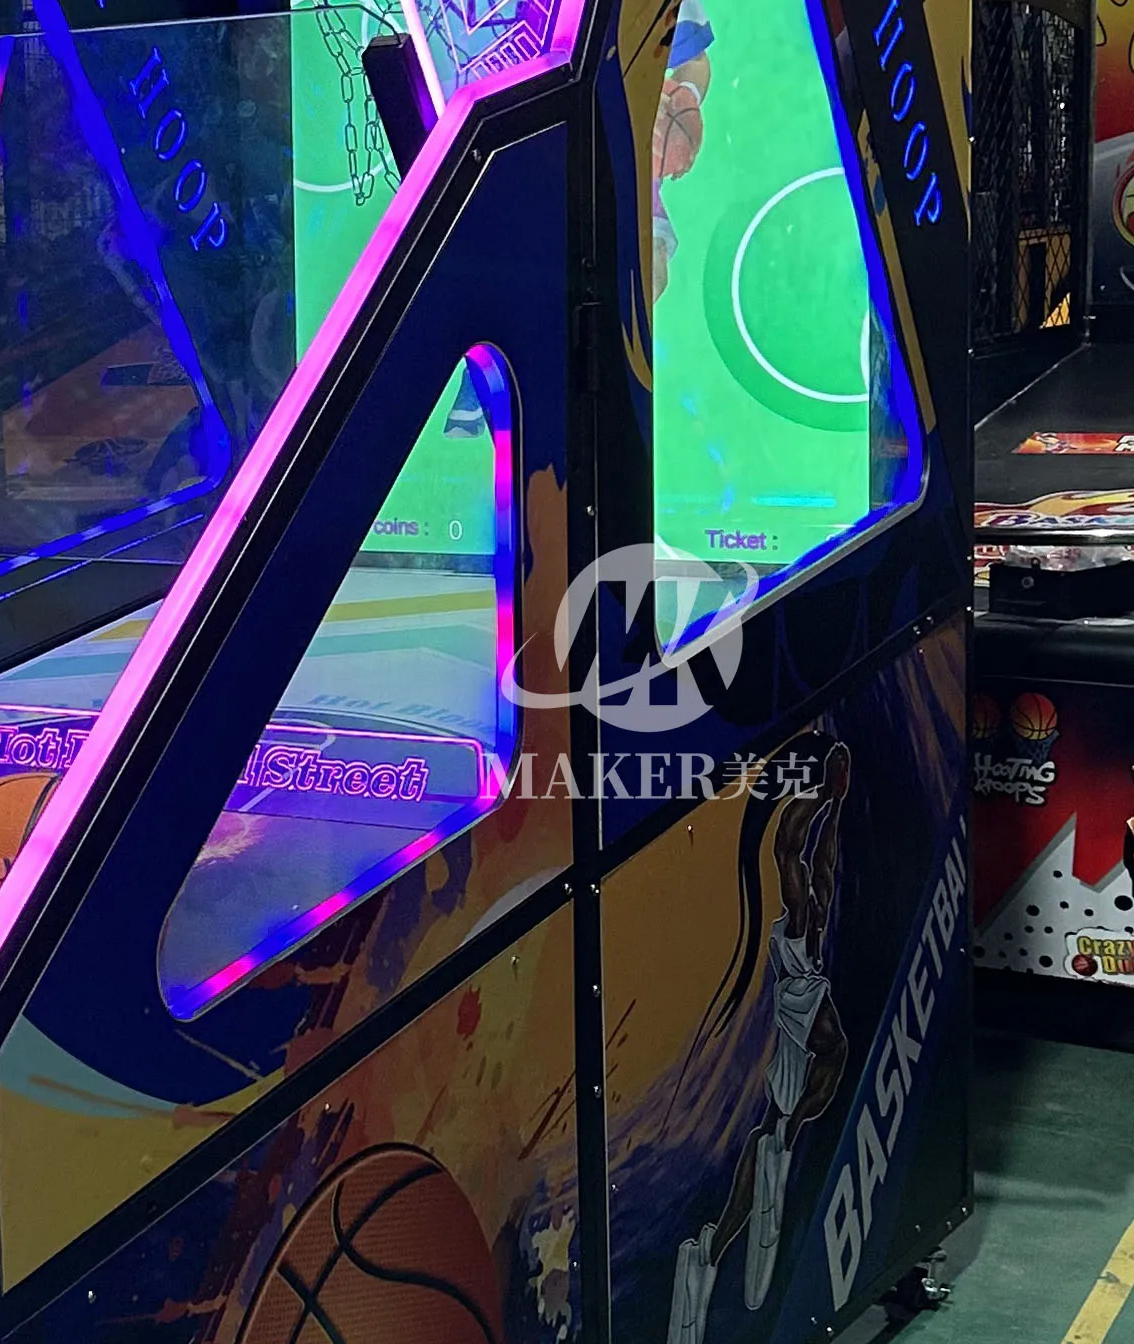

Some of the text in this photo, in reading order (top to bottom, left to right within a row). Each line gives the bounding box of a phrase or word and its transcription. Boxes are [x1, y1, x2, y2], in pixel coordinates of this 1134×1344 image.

[129, 46, 229, 252] HOOP
[449, 520, 463, 540] 0
[263, 745, 429, 802] Street
